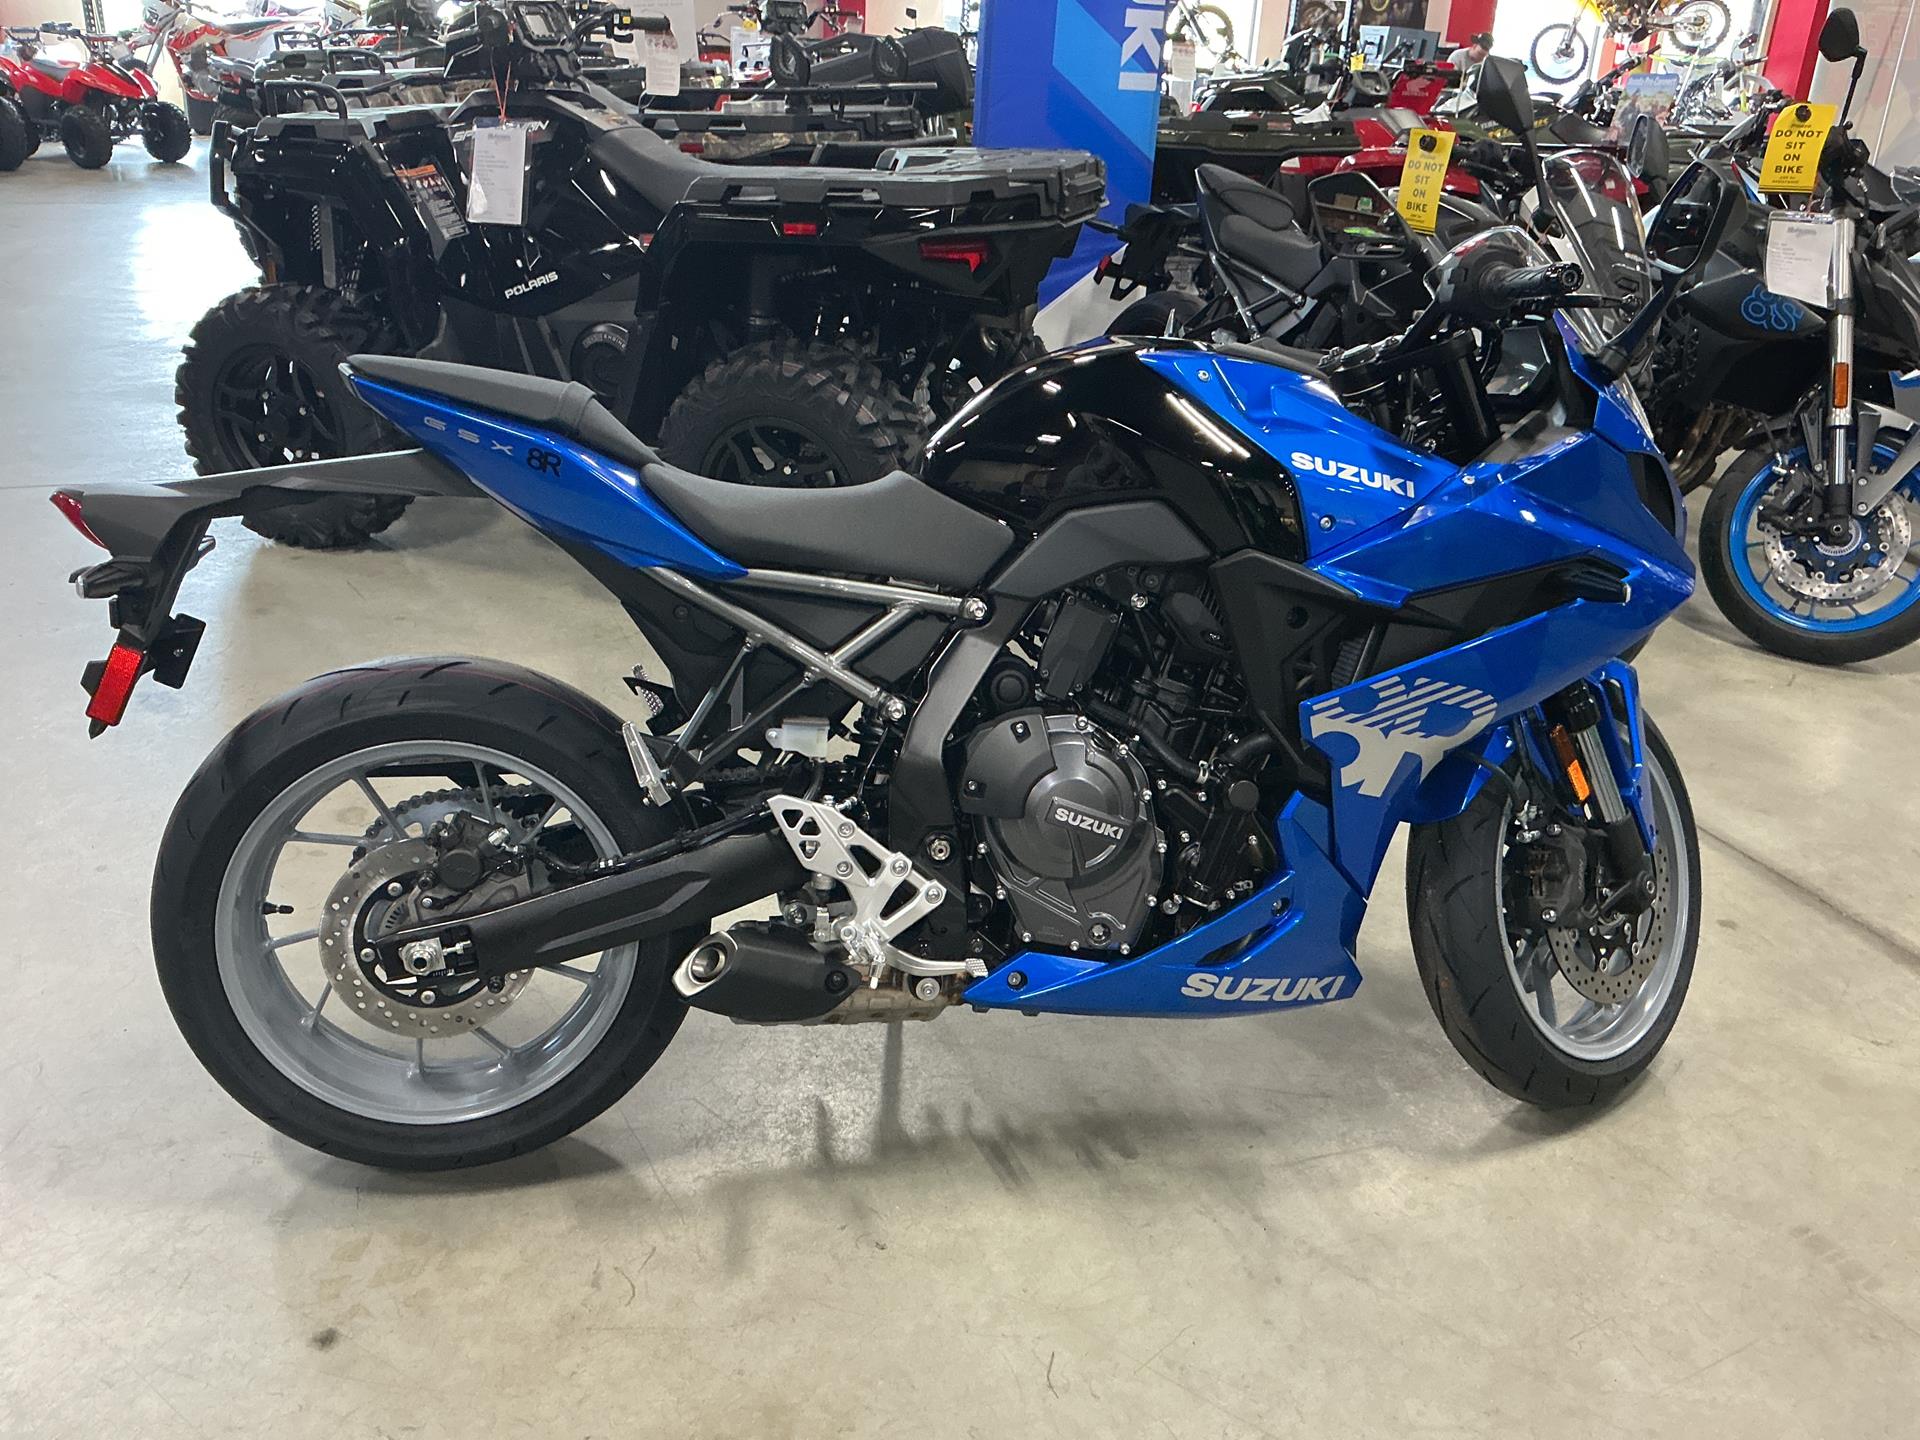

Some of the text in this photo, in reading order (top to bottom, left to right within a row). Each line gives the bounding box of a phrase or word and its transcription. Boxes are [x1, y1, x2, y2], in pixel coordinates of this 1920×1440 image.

[1118, 0, 1166, 91] KI
[1775, 129, 1823, 138] DO NOT
[1785, 141, 1805, 150] SIT
[1783, 153, 1800, 162] ON
[1408, 160, 1444, 173] DO NOT
[1774, 165, 1804, 174] BIKE
[1414, 175, 1430, 185] SIT
[1412, 188, 1426, 199] ON
[1406, 201, 1428, 213] BIKE
[504, 271, 559, 299] POLARIS
[527, 447, 562, 478] 8R
[1290, 451, 1415, 499] SUZUKI
[1054, 807, 1124, 840] SUZUKI
[1180, 972, 1346, 1002] SUZUKI
